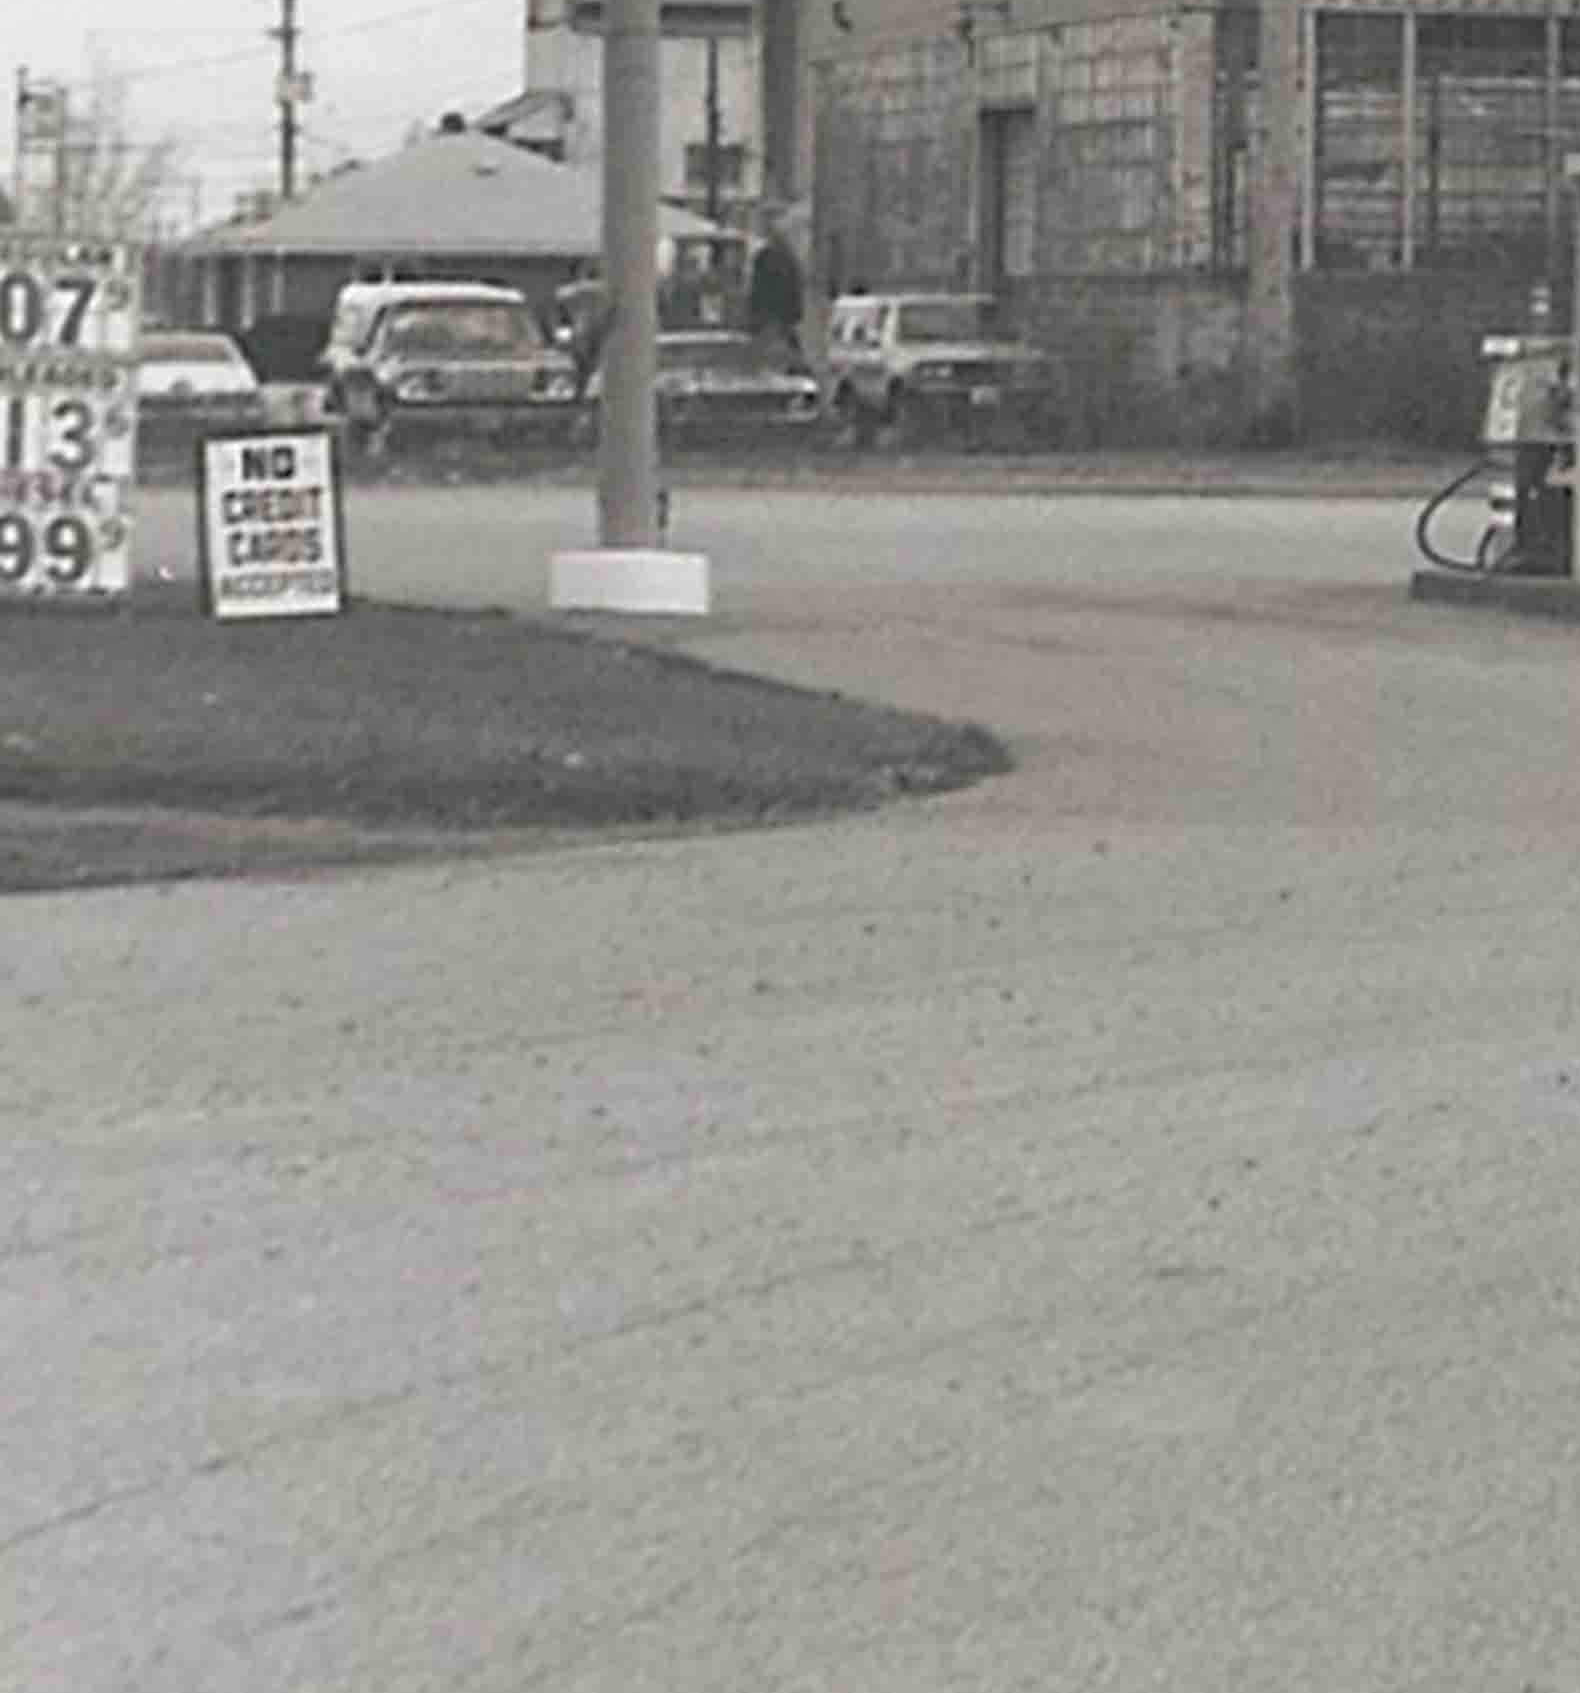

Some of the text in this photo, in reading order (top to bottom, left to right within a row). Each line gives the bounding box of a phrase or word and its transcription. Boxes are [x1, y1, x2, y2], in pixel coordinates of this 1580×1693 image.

[242, 446, 296, 482] NO
[221, 485, 323, 526] CREDIT
[228, 525, 323, 568] CARDS
